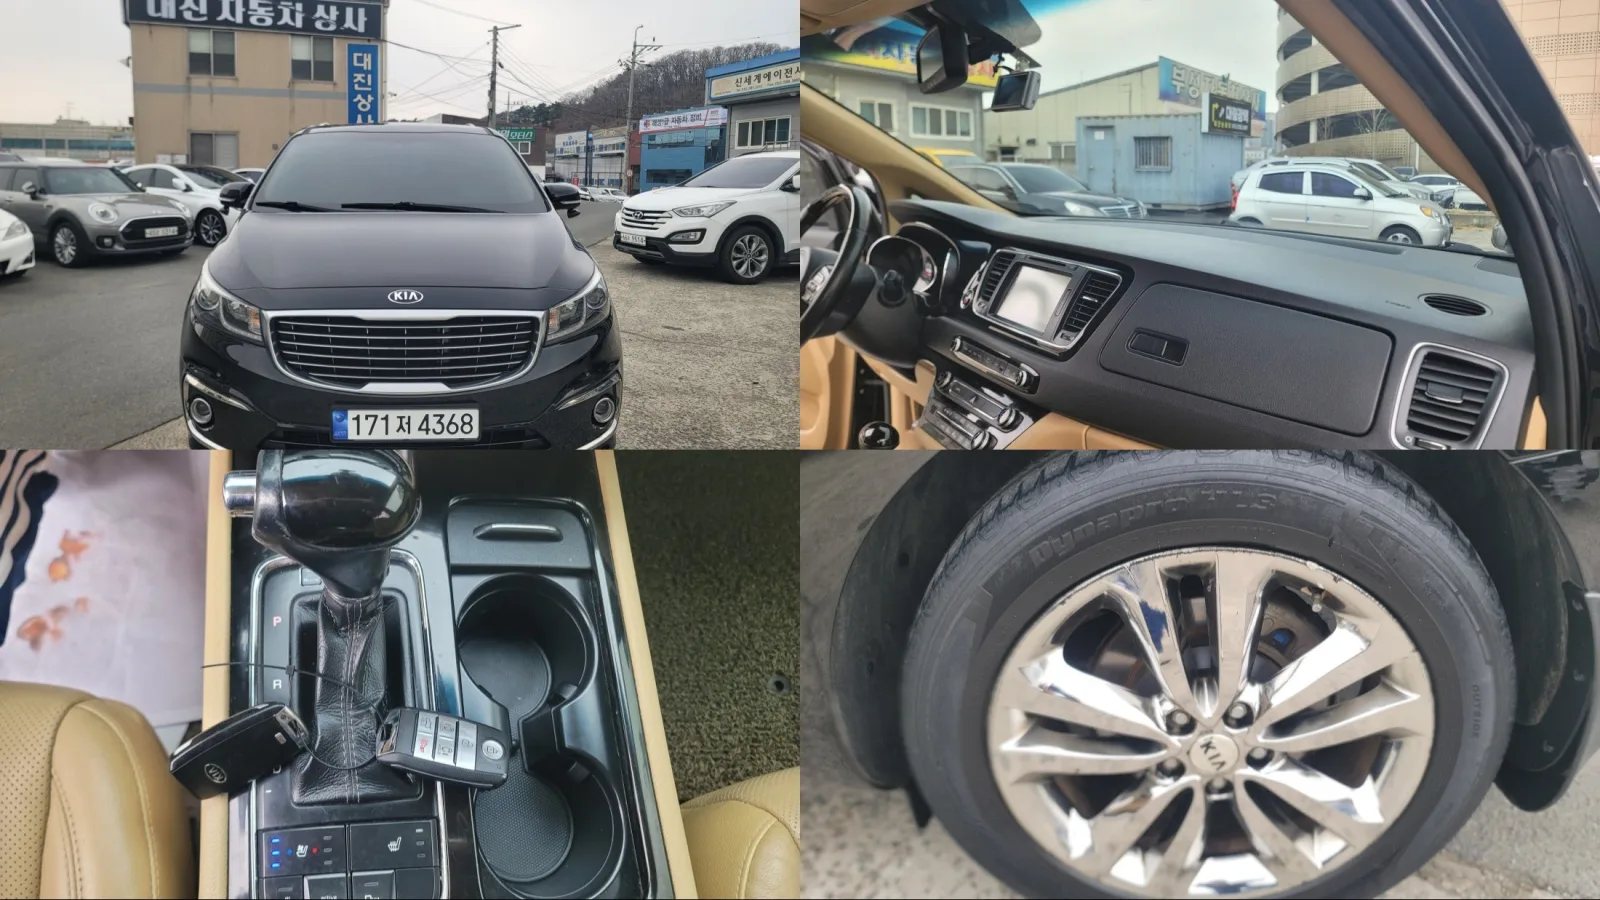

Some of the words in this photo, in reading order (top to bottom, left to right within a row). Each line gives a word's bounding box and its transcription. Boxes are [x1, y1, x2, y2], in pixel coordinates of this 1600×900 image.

[216, 0, 305, 29] 자동차
[312, 4, 368, 33] 상사
[394, 291, 419, 301] KIA
[351, 413, 412, 436] 171저
[417, 413, 474, 436] 4368
[273, 616, 282, 627] P
[273, 679, 282, 690] R
[1199, 739, 1228, 772] KIA
[208, 766, 224, 782] KIA
